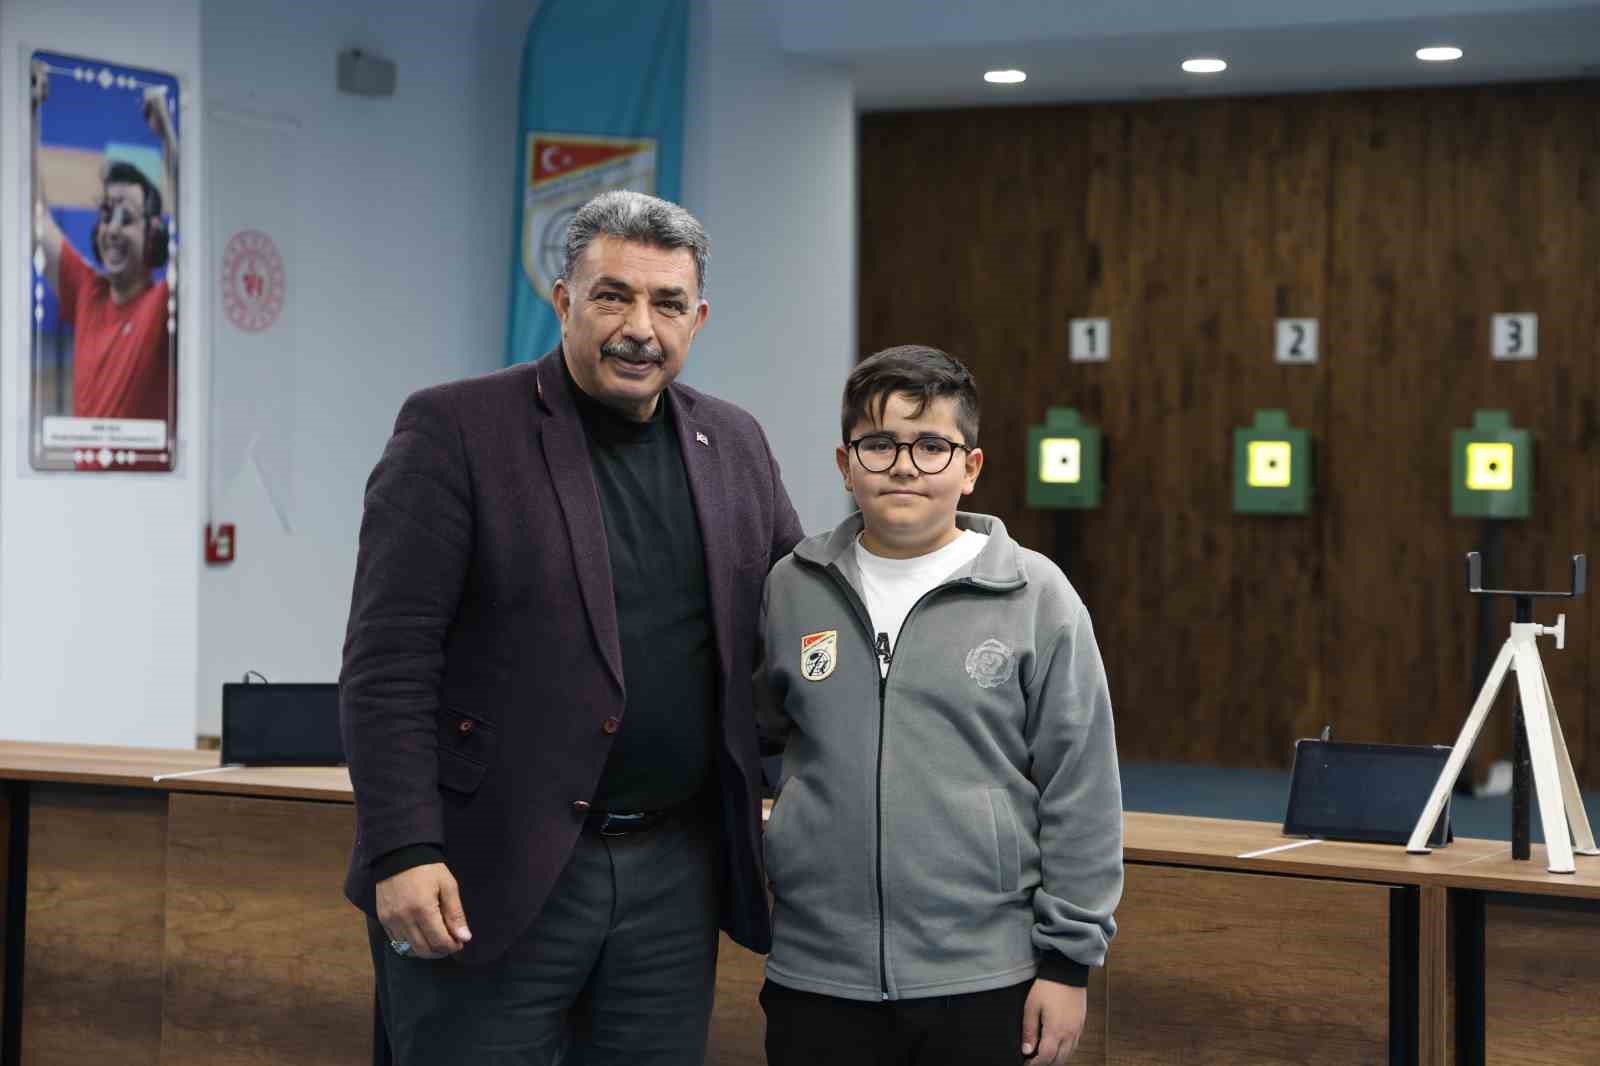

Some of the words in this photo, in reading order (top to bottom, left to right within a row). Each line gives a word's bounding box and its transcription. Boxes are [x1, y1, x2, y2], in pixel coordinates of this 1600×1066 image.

[1085, 325, 1097, 354] 1
[1290, 324, 1305, 356] 2
[1507, 319, 1523, 353] 3
